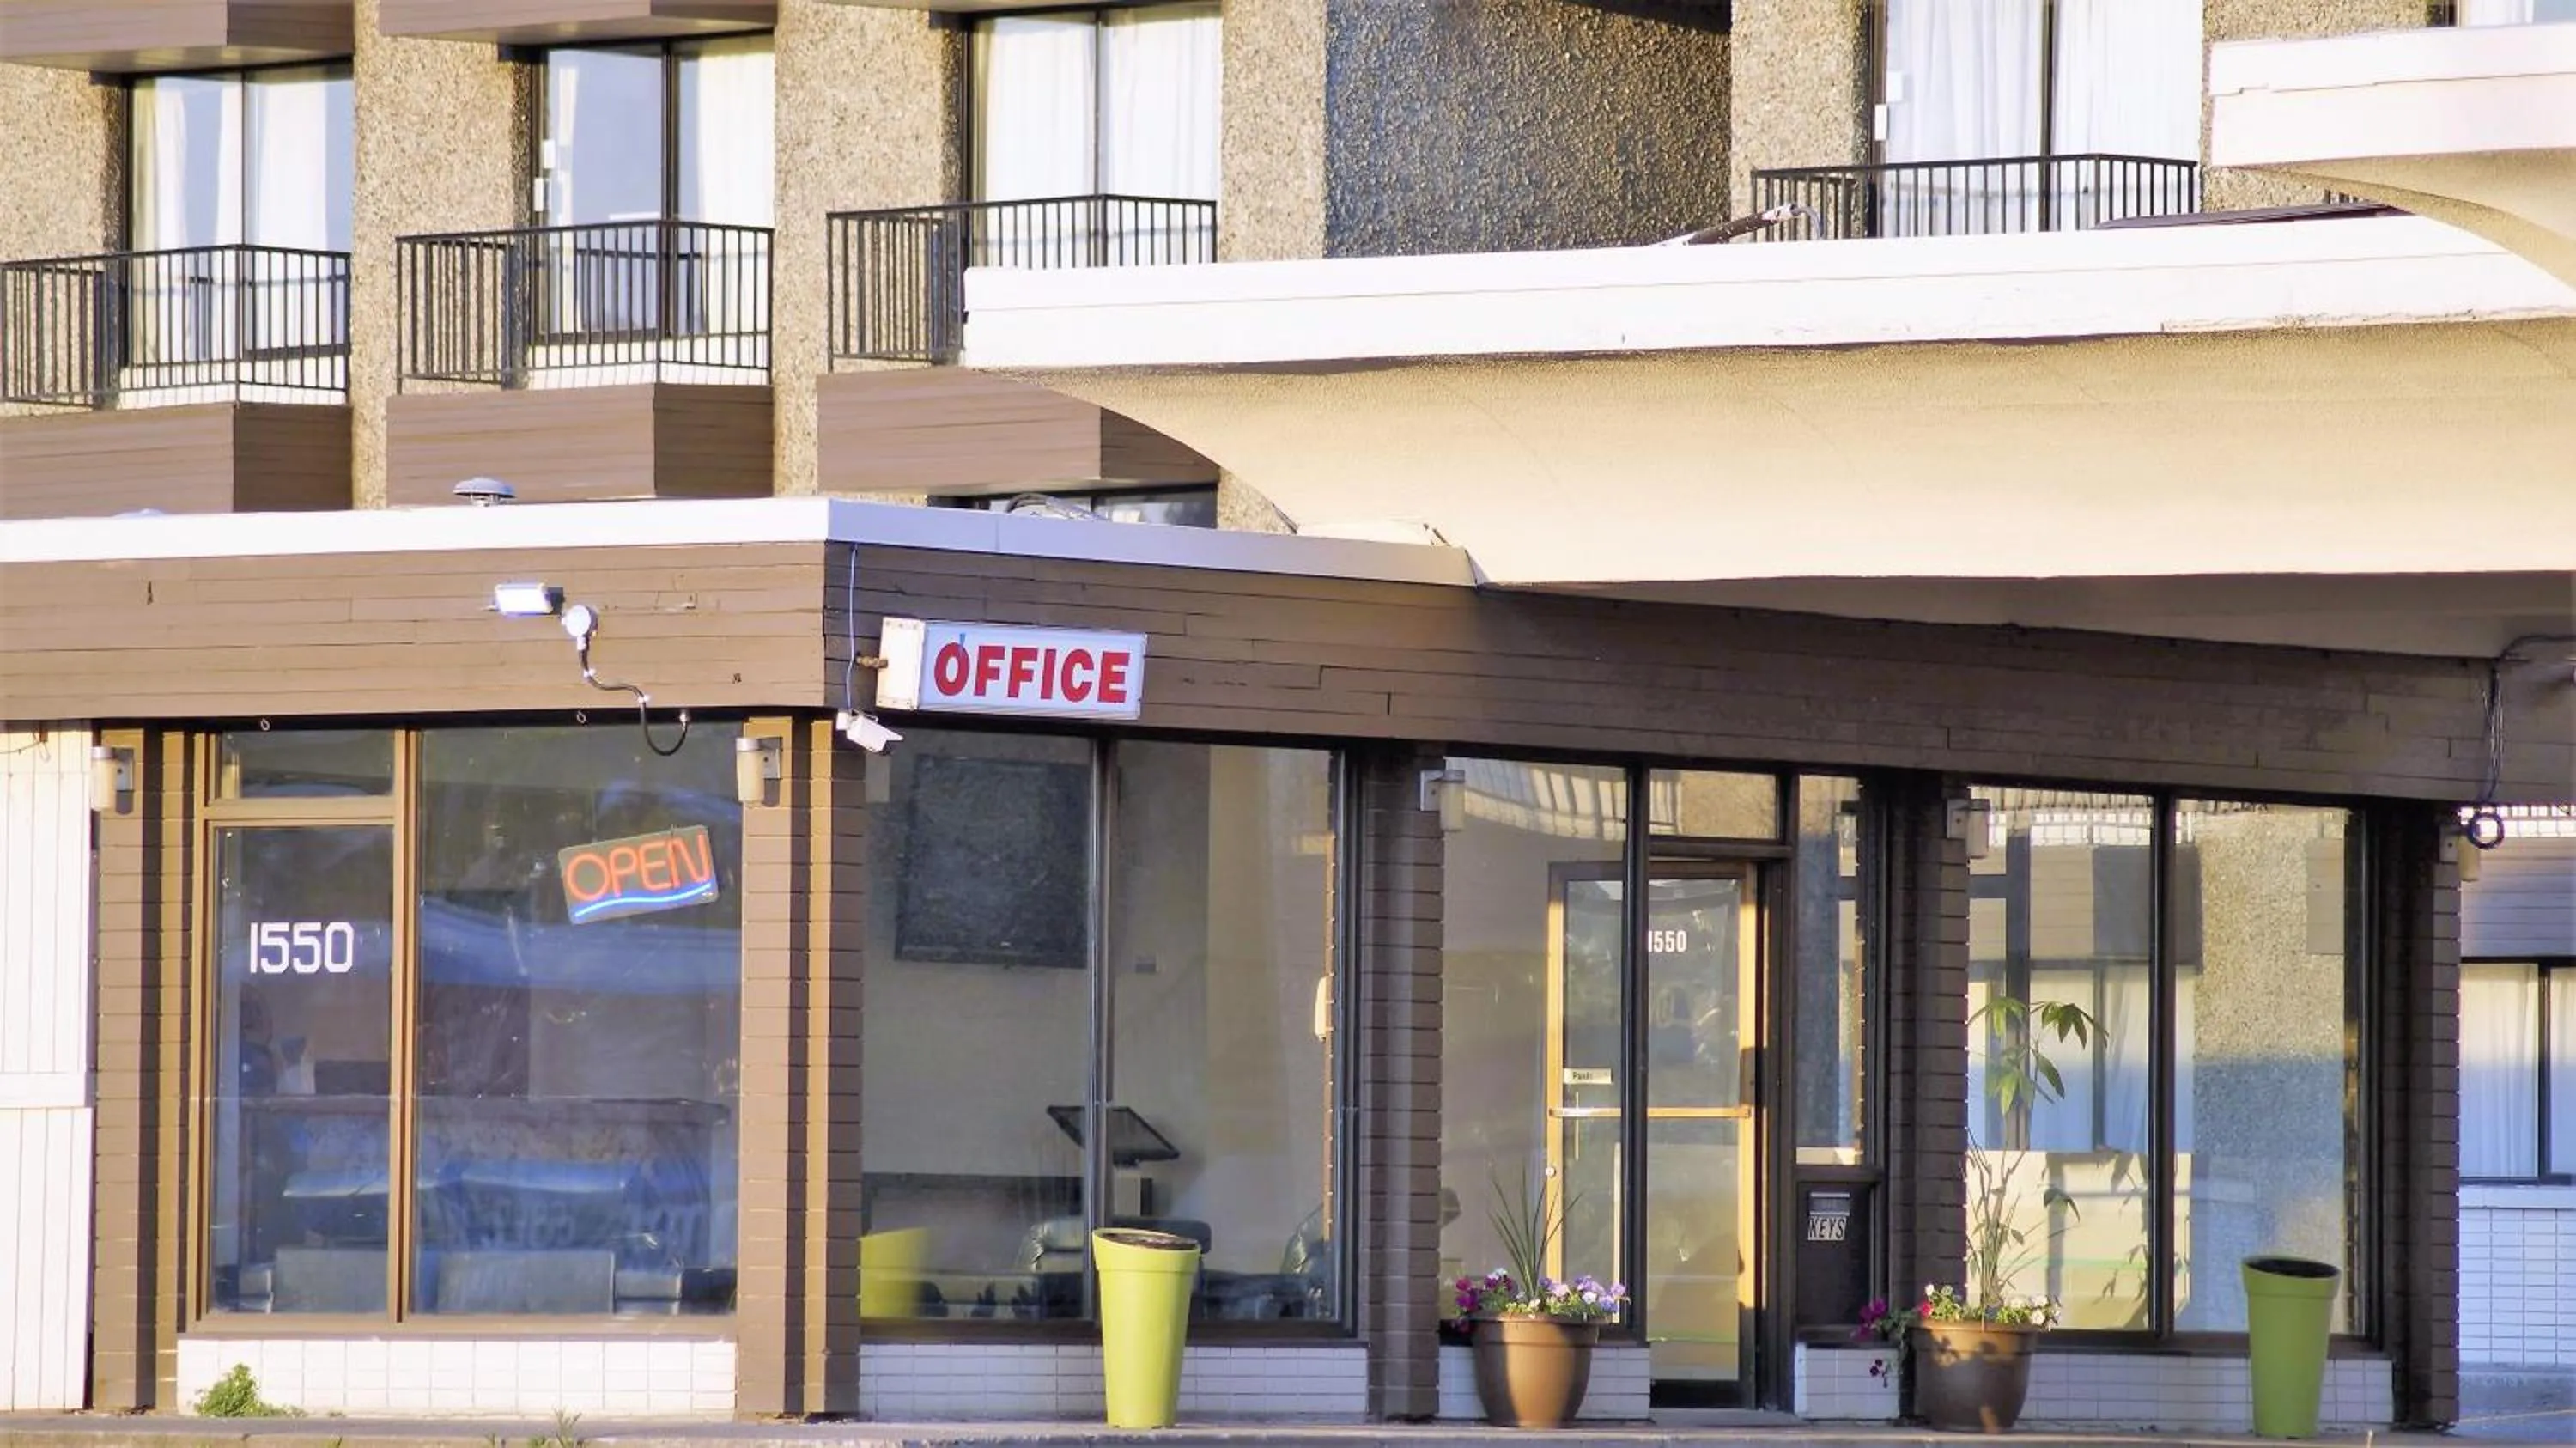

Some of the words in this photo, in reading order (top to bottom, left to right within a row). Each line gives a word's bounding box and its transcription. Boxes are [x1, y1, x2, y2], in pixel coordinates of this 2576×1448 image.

[933, 642, 1130, 703] OFFICE
[566, 831, 712, 902] OPEN
[250, 922, 354, 973] 1550
[1648, 930, 1687, 952] 1550
[1807, 1216, 1845, 1238] KEYS
